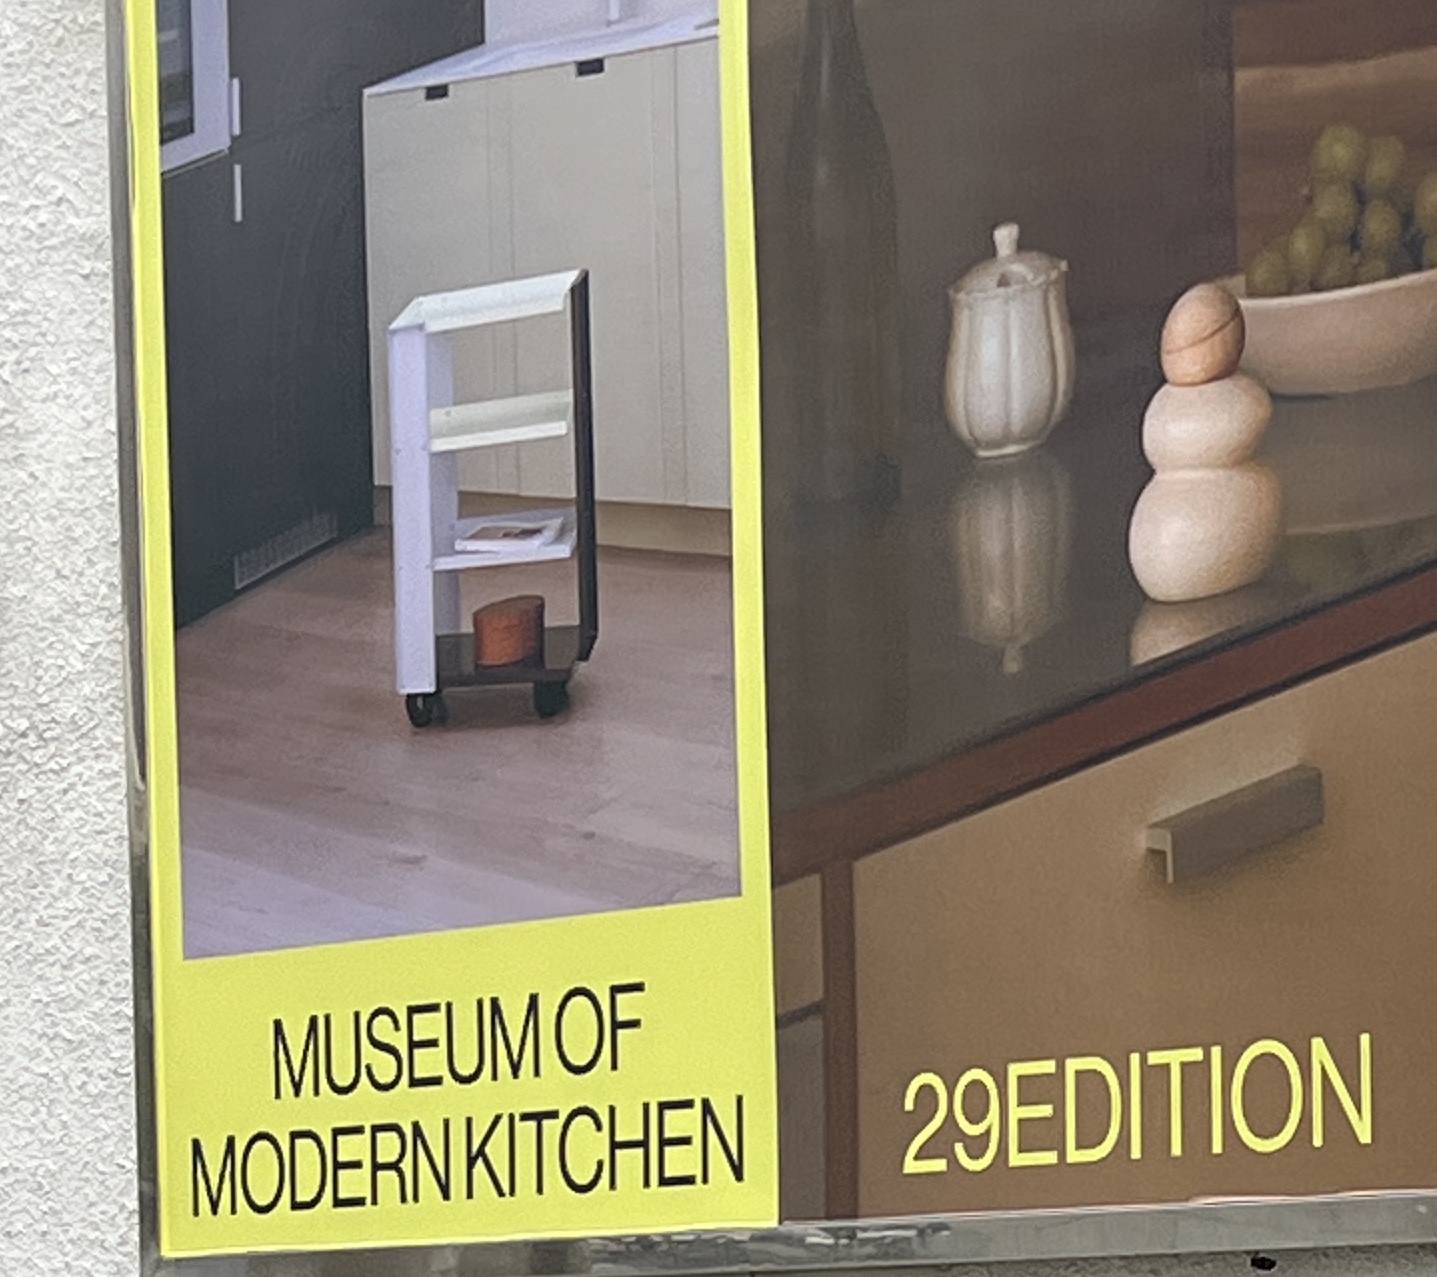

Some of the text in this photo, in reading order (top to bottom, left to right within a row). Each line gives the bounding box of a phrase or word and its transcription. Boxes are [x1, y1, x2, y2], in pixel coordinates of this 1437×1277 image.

[273, 981, 646, 1099] MUSEUM OF
[191, 1094, 745, 1217] MODERN KITCHEN
[902, 1032, 1372, 1174] 29EDITION
